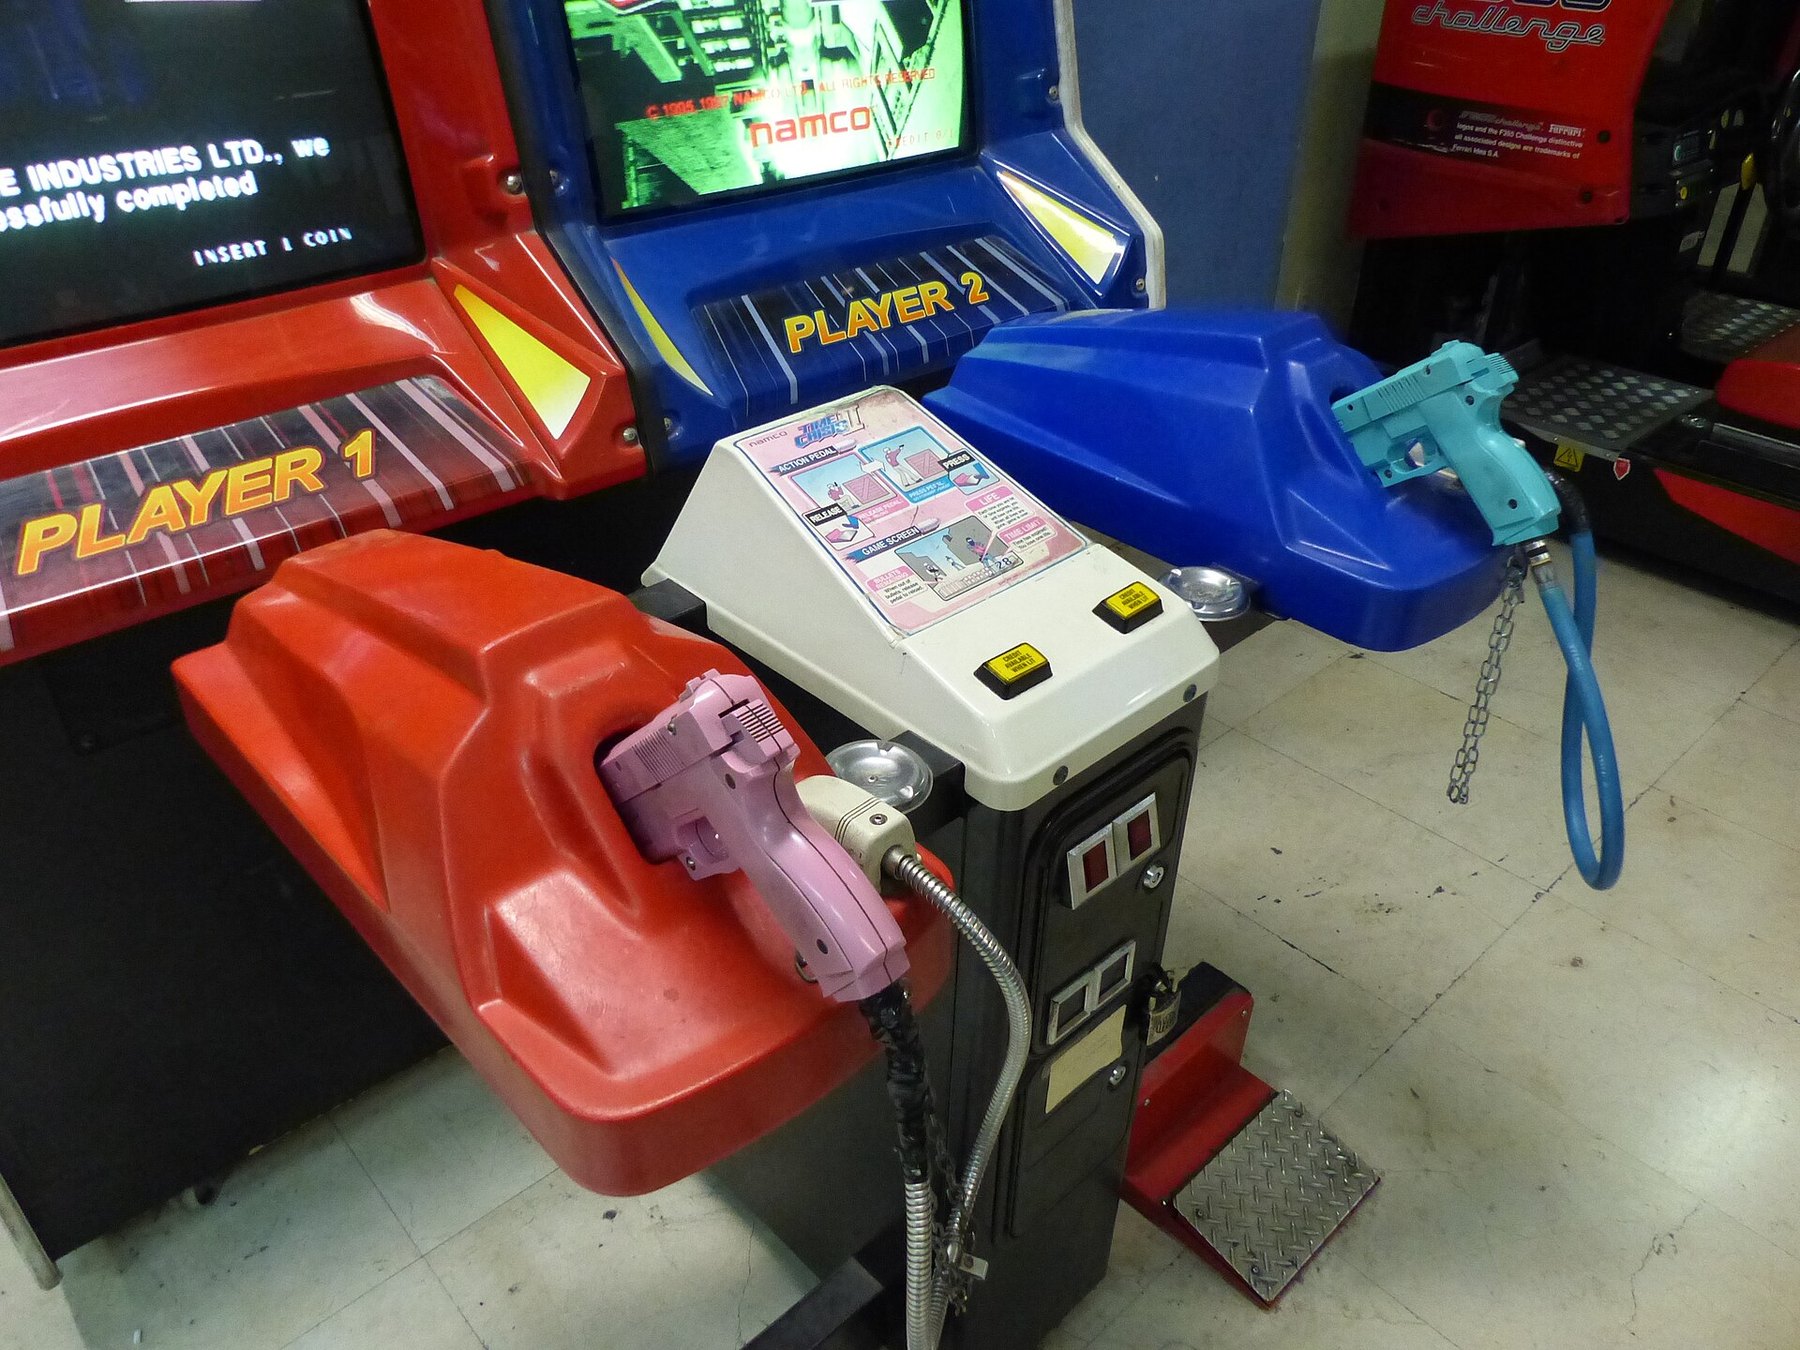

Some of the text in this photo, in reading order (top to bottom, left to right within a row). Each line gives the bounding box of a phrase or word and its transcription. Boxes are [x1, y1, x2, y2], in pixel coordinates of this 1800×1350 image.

[884, 67, 936, 85] RESERVED
[750, 105, 870, 149] namco
[26, 145, 202, 192] INDUSTRIES
[207, 138, 284, 169] LTD.,
[291, 137, 330, 158] we
[116, 170, 259, 213] completed
[193, 239, 267, 266] INSERT
[303, 227, 352, 247] COIN
[784, 271, 990, 354] PLAYER 2
[749, 430, 788, 448] namco
[778, 446, 837, 473] ACTION PEDAL
[943, 452, 972, 469] PRESS
[17, 429, 374, 575] PLAYER 1
[979, 493, 1000, 506] LIFE
[809, 507, 843, 524] RELEASE
[862, 527, 920, 556] GAME SCREEN
[1004, 528, 1023, 540] TIME
[1003, 650, 1022, 662] CREDIT
[1004, 653, 1032, 668] AVAILABLE
[1011, 662, 1028, 672] WHEN
